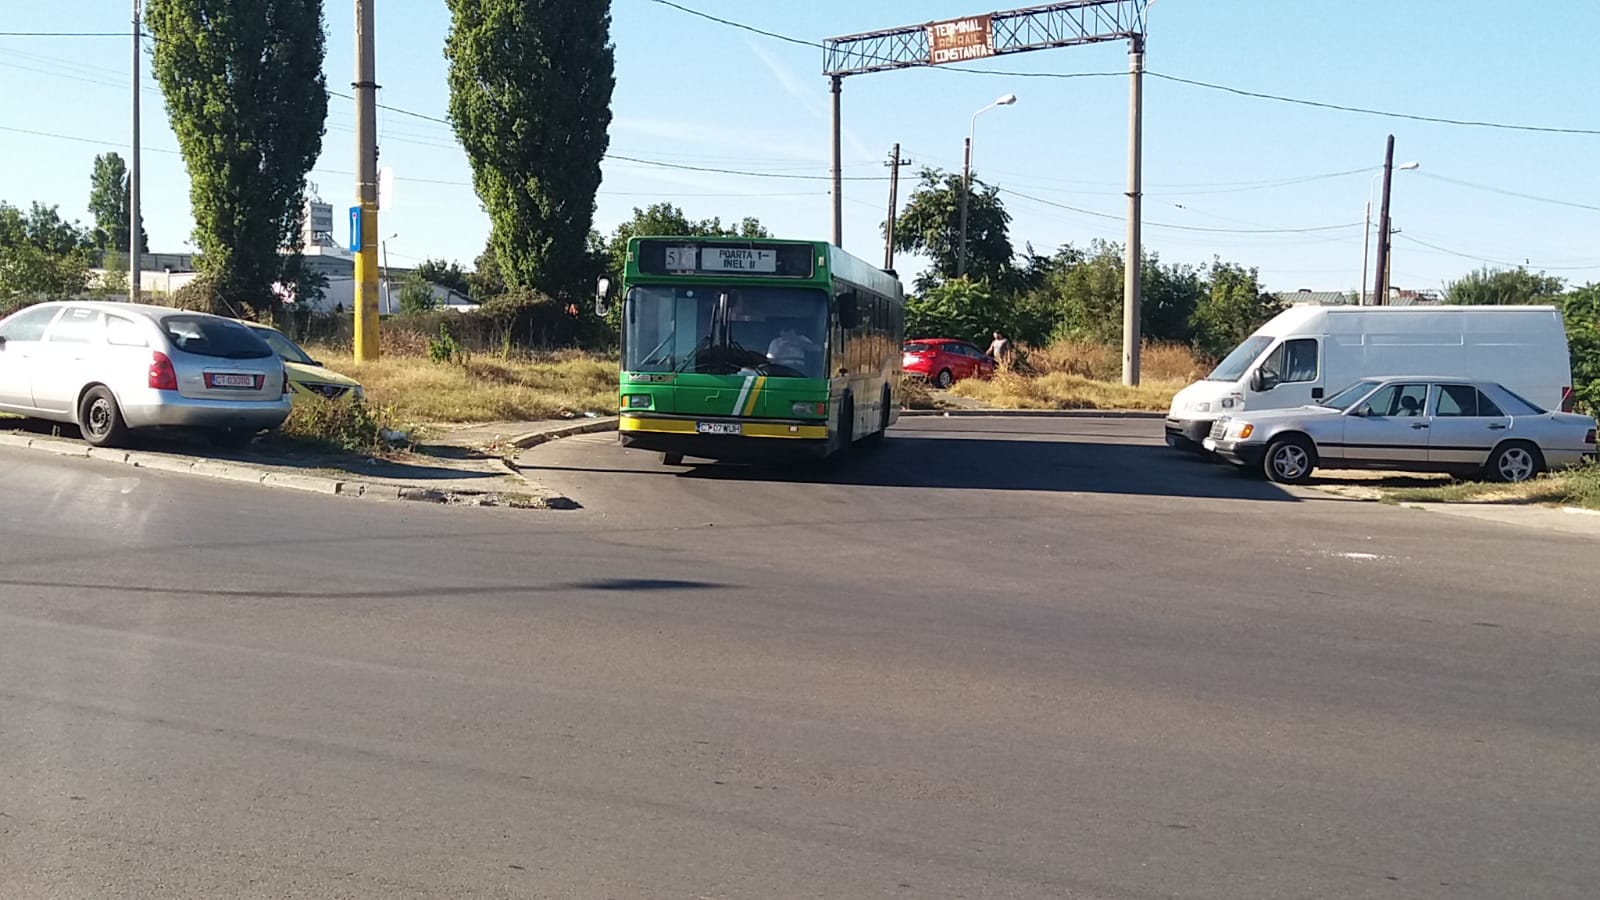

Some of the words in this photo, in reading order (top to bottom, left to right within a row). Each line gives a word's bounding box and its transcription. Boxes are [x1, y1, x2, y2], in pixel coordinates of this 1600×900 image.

[934, 18, 983, 37] TERMINAL
[934, 43, 988, 63] CONSTANTA
[719, 249, 753, 260] POARTA
[723, 259, 745, 269] INEL
[215, 375, 226, 385] CT
[700, 423, 710, 432] CT
